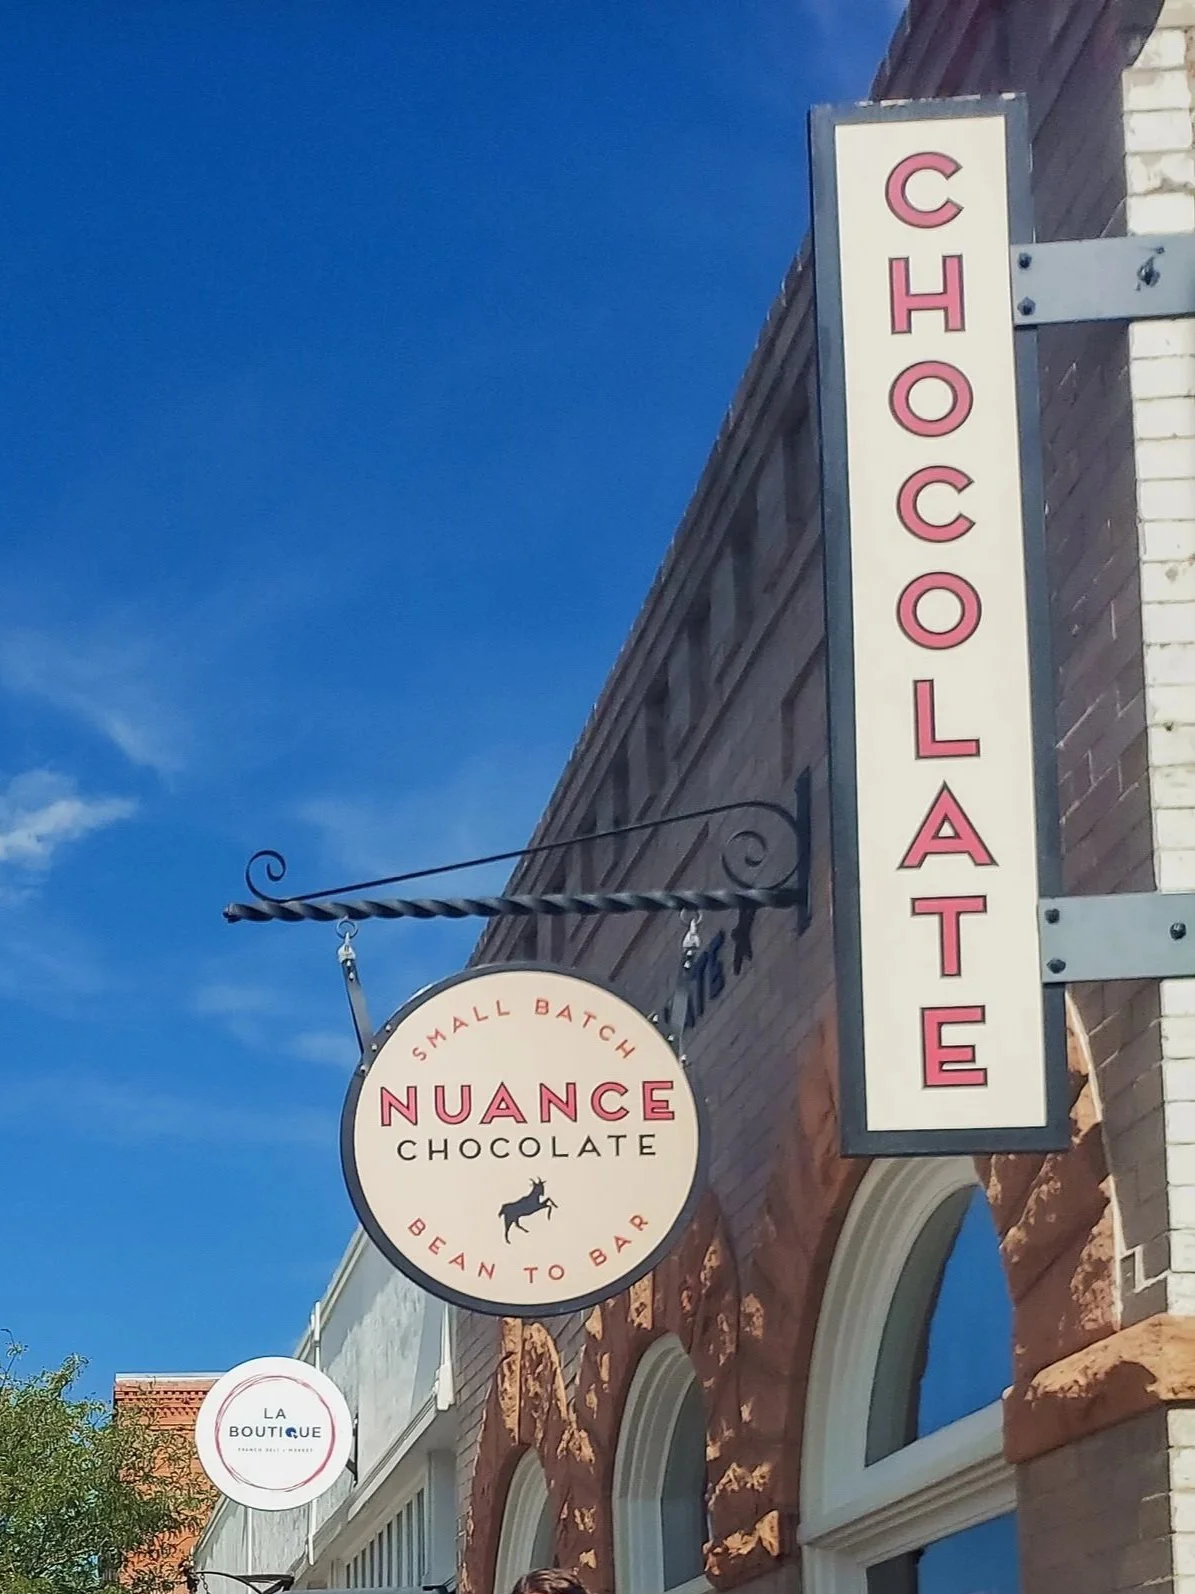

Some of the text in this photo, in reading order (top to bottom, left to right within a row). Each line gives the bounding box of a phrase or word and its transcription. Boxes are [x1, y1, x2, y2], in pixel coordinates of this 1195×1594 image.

[885, 151, 998, 1088] CHOCOLATE
[411, 998, 636, 1062] SMALL BATCH
[380, 1080, 675, 1126] NUANCE
[397, 1134, 656, 1161] CHOCOLATE
[408, 1214, 649, 1284] BEAN TO BAR
[229, 1426, 321, 1439] BOUTIQUE
[264, 1408, 287, 1419] LA
